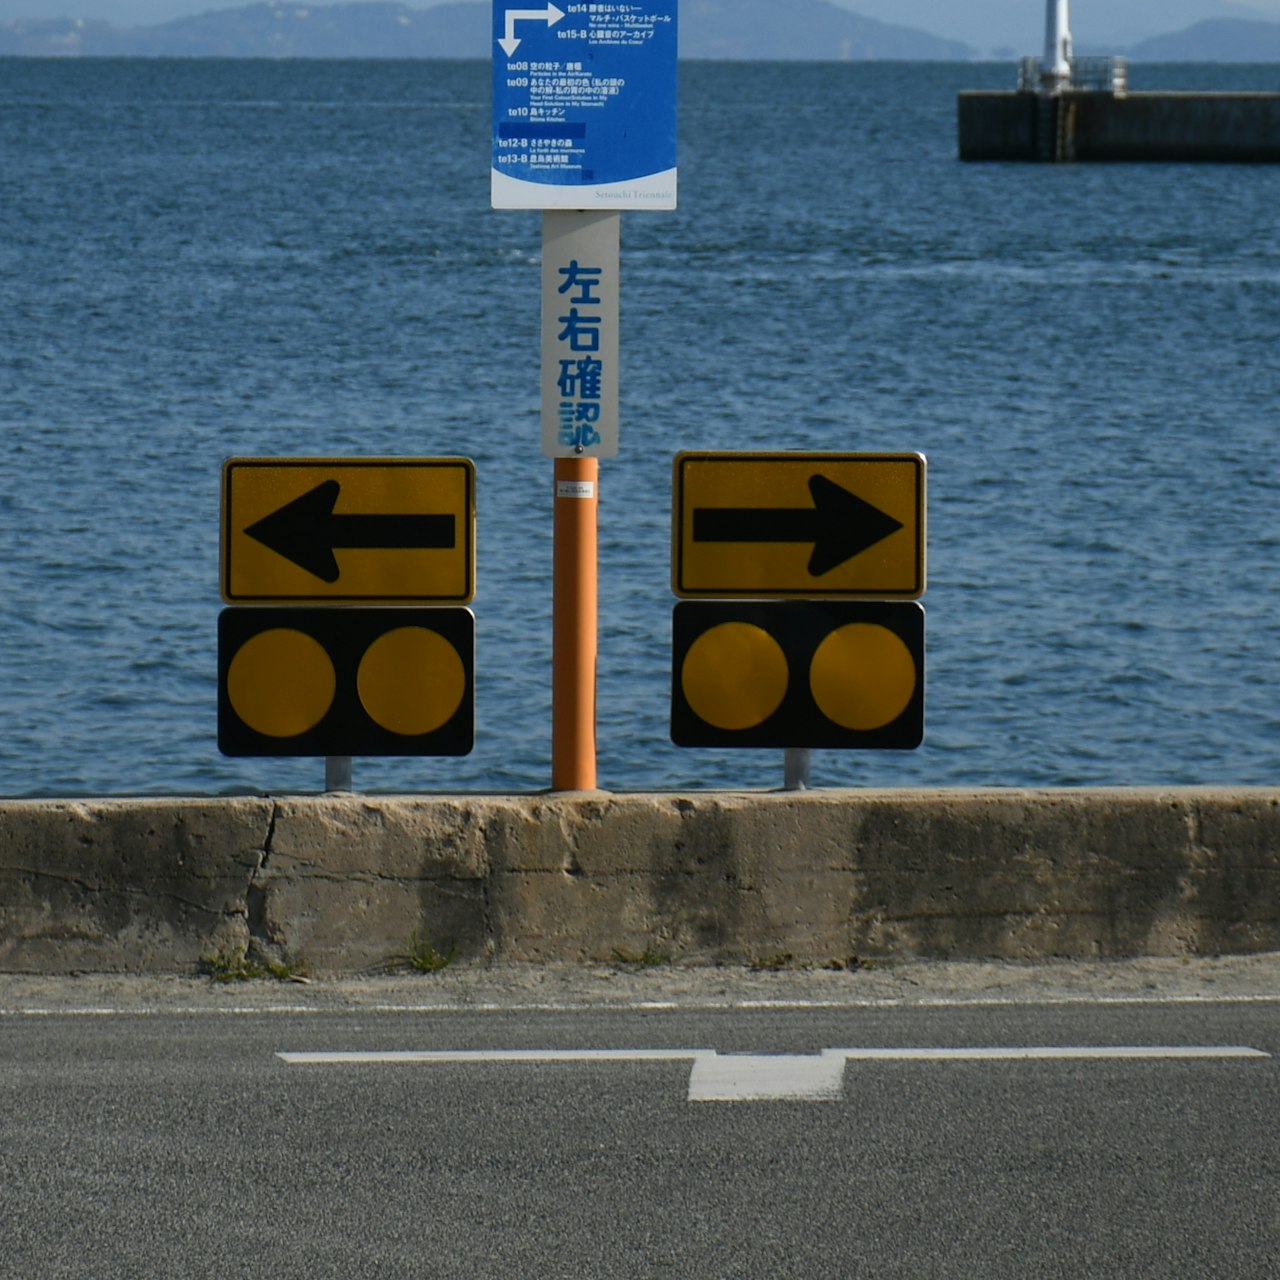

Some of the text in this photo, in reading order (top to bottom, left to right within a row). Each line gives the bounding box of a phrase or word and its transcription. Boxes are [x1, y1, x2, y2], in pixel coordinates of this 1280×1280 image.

[567, 4, 587, 13] to14
[557, 30, 587, 39] to15-B
[507, 62, 528, 71] to08
[507, 78, 528, 87] to09
[508, 107, 566, 116] to10 島キッチン
[595, 190, 672, 200] Setouchi Triennale
[557, 259, 602, 447] 左右確認
